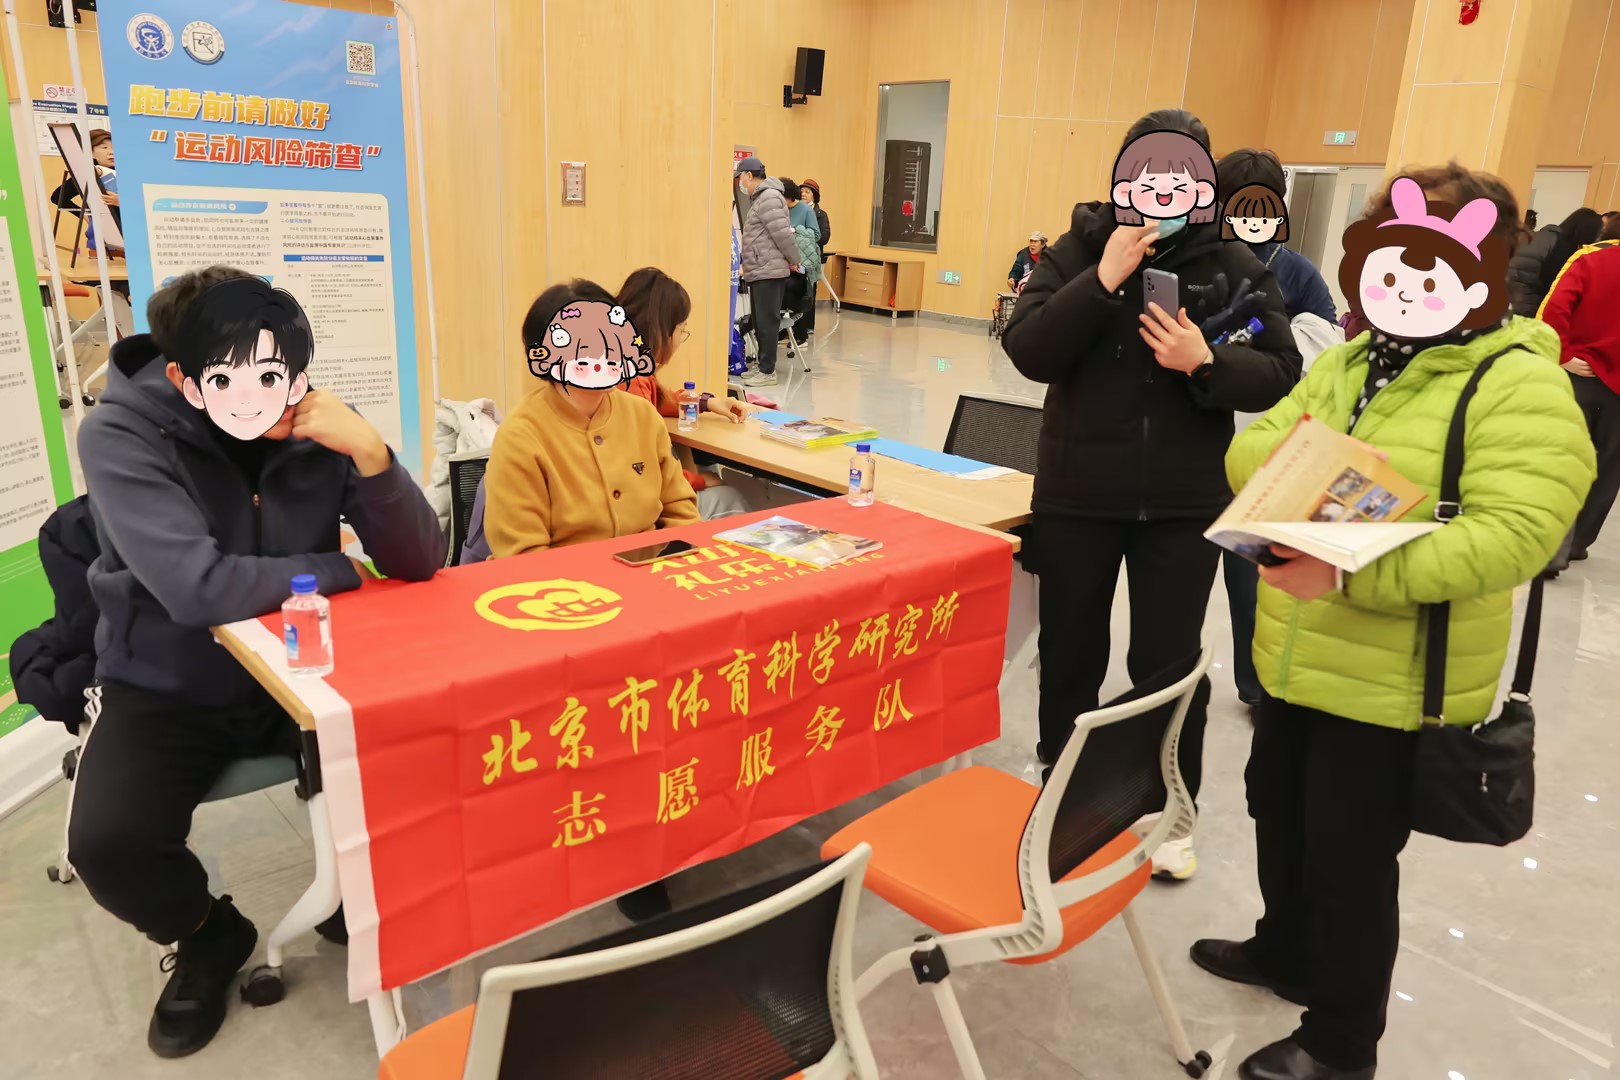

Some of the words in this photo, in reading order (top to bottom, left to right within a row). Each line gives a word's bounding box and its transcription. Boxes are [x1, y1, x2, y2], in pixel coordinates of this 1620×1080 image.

[129, 84, 330, 130] 跑步前请做好
[149, 130, 382, 171] “运动风险筛查”
[483, 591, 959, 785] 北京市体育科学研究所
[552, 679, 914, 850] 志愿服务队
